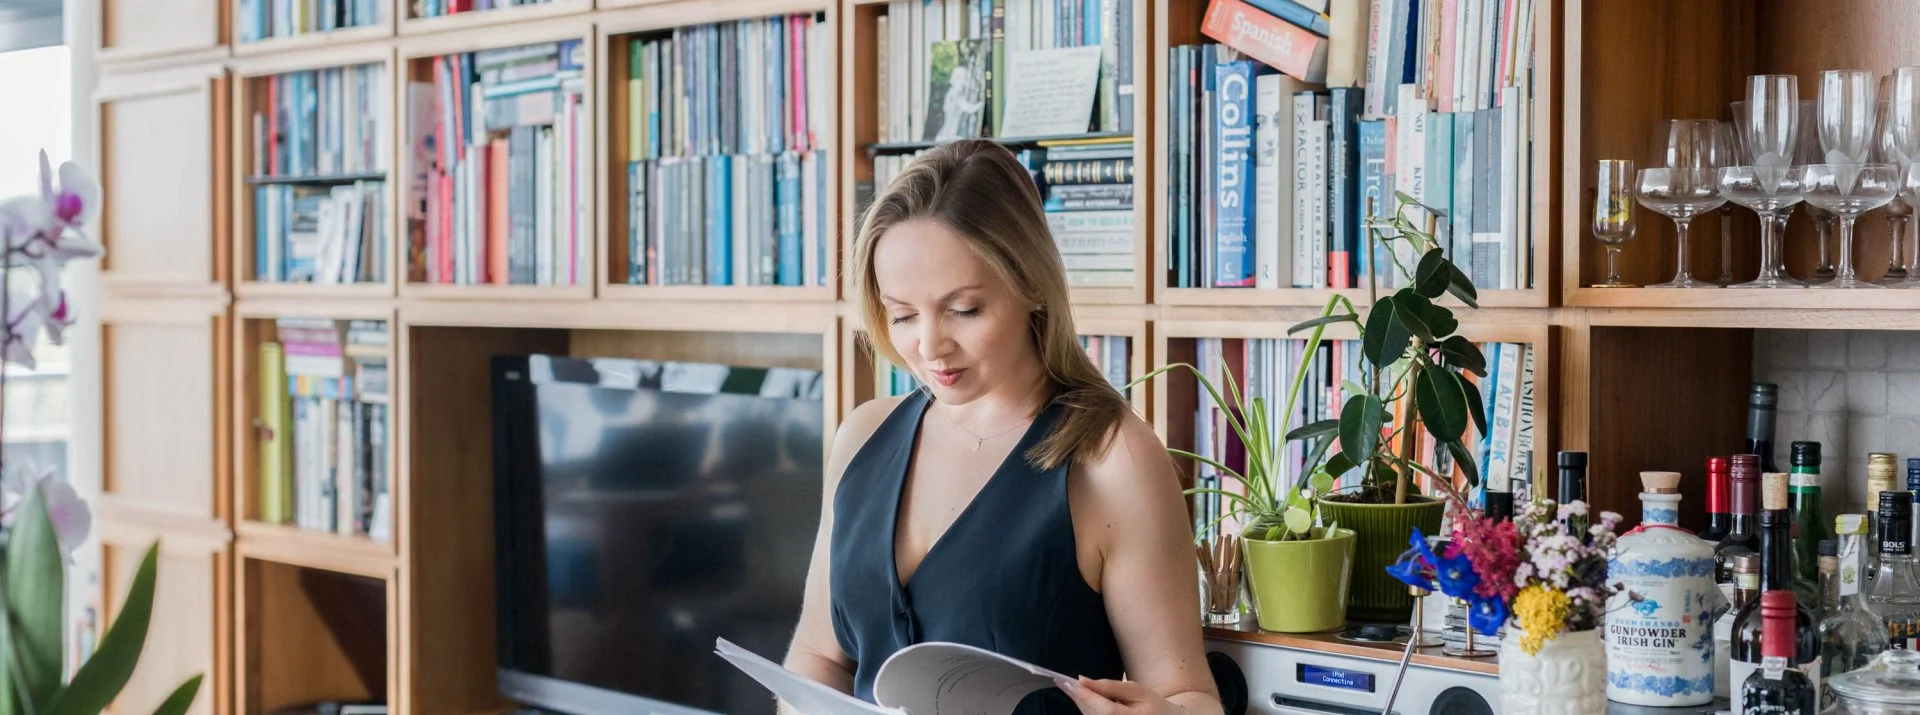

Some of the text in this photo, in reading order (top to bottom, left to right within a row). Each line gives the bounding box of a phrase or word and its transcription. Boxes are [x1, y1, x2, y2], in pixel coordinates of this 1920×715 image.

[1231, 11, 1293, 55] Spanish
[1415, 112, 1424, 134] NOT
[1220, 73, 1251, 209] Collins
[1297, 129, 1308, 191] FACTOR
[1414, 167, 1422, 195] KIND
[1493, 416, 1510, 463] BOOK
[1610, 624, 1687, 639] GUNPOWDER
[1617, 636, 1675, 648] IRISH GIN
[1322, 676, 1354, 686] Connecting
